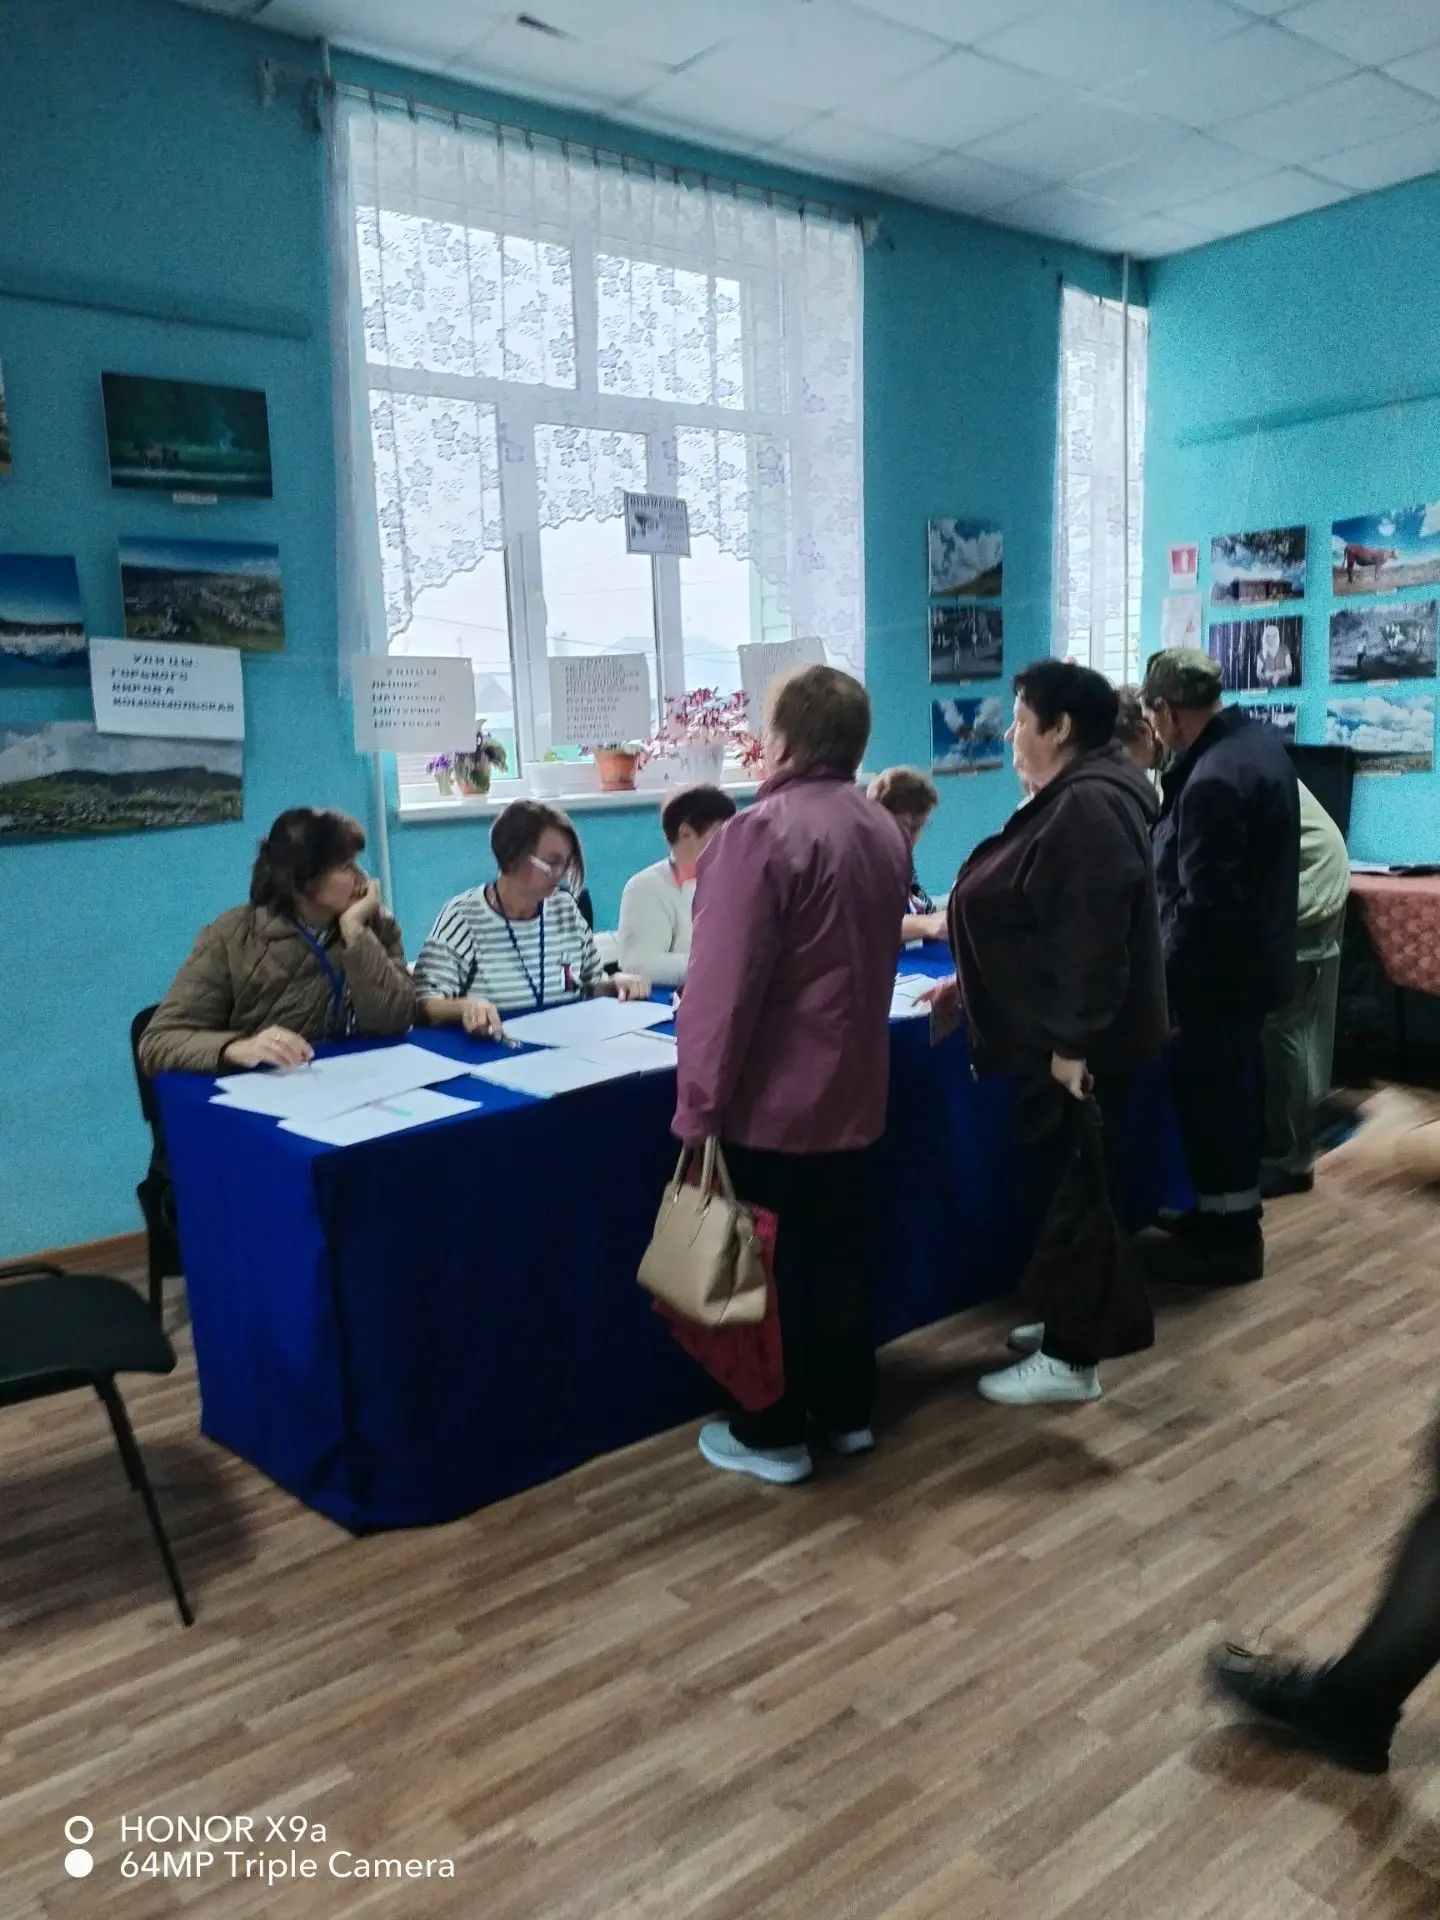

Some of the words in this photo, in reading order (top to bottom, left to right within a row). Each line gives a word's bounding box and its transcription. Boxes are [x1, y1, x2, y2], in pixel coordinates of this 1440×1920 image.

[111, 667, 188, 682] ГОРЬКОГО
[112, 682, 176, 695] КИРОВА
[113, 697, 234, 713] КОМСОМОЛЬСКАЯ
